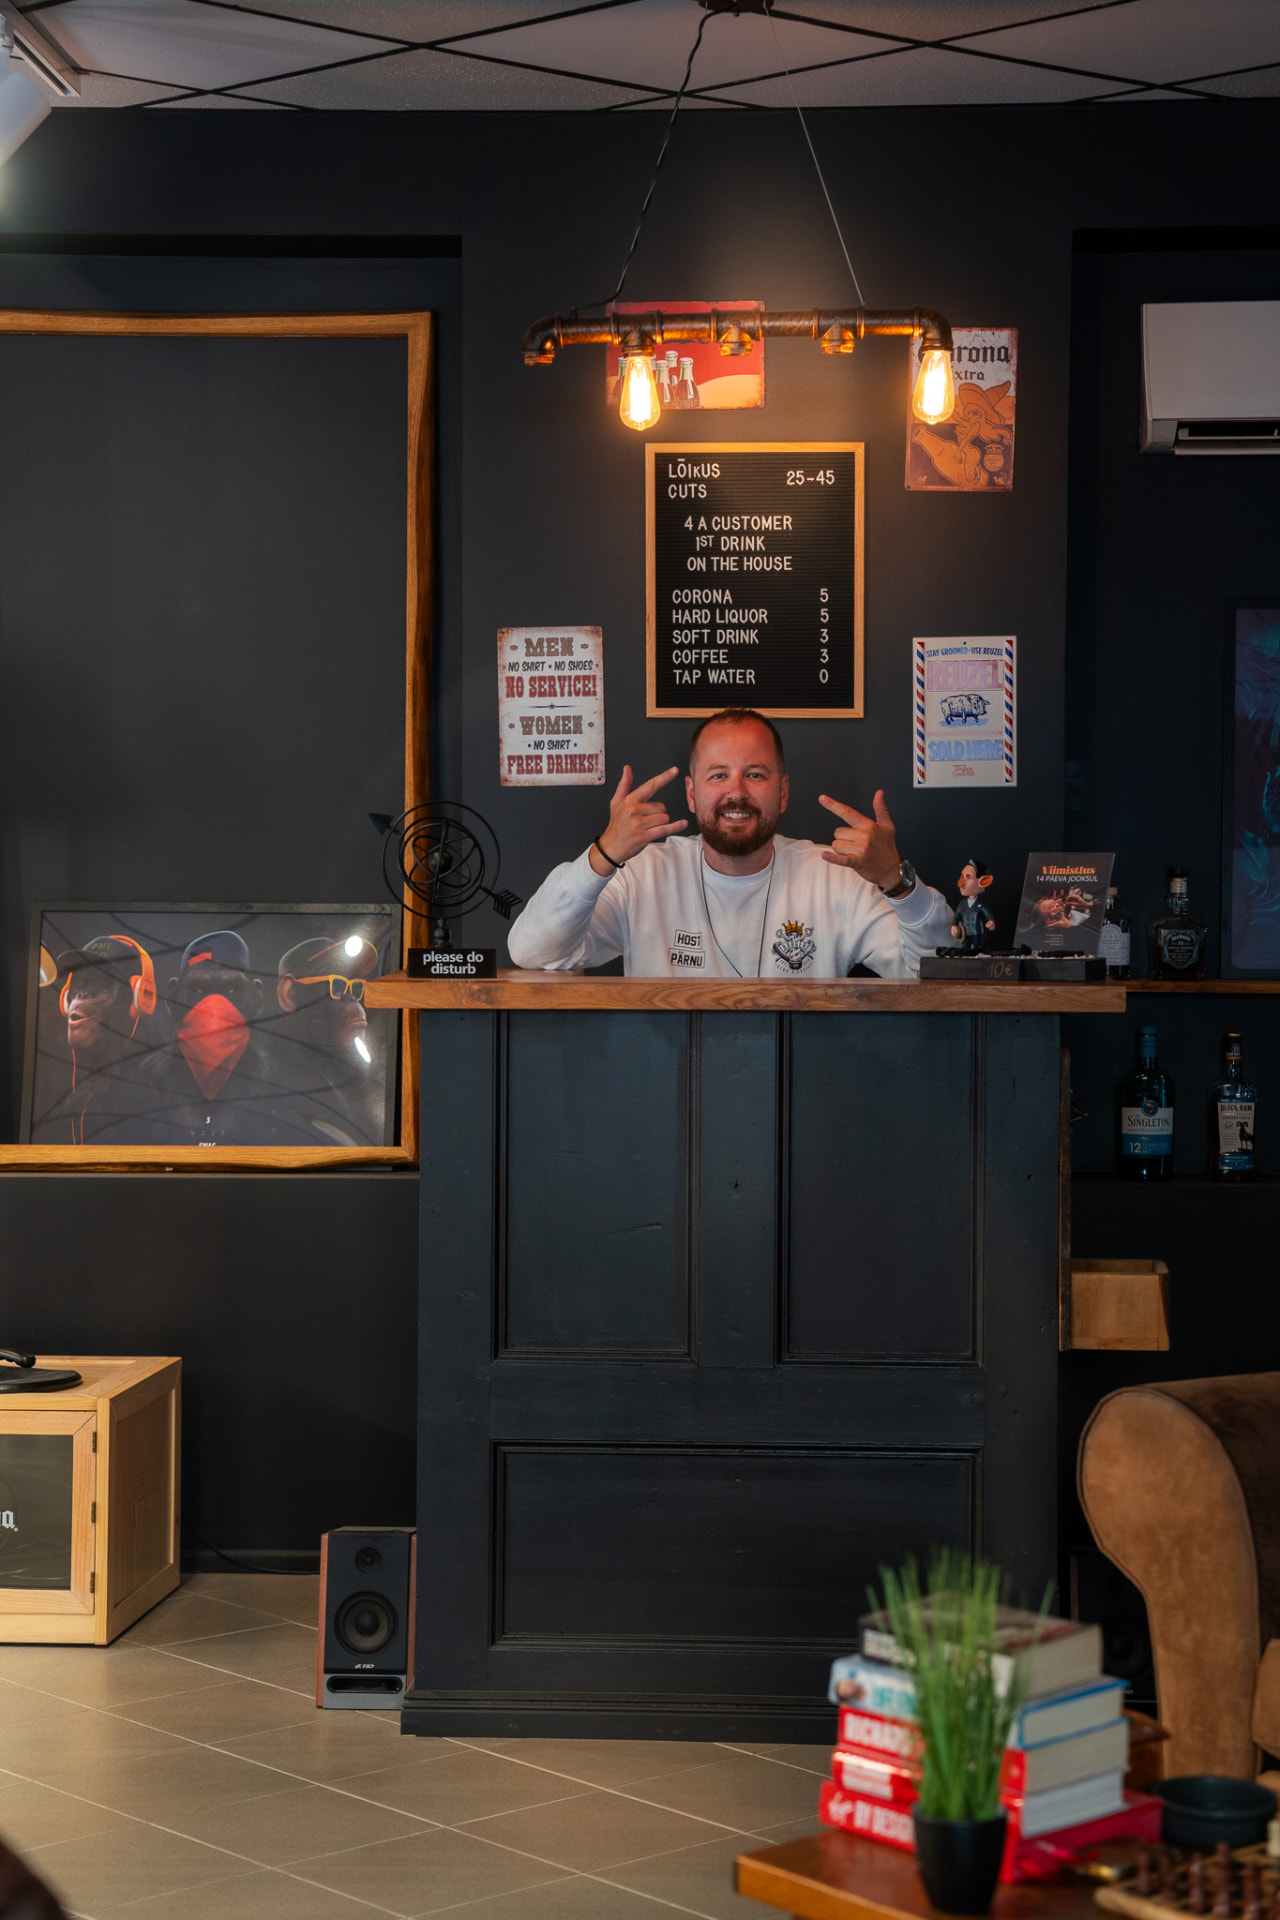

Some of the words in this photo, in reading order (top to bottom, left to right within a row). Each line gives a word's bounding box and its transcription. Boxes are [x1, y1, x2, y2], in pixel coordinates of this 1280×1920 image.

[786, 470, 835, 486] 25-45
[668, 484, 707, 499] CUTS
[684, 515, 694, 530] 4
[698, 515, 708, 530] A
[712, 515, 792, 531] CUSTOMER
[695, 535, 715, 551] 1ST
[721, 536, 765, 551] DRINK
[687, 556, 706, 572] ON
[711, 556, 739, 571] THE
[743, 556, 792, 571] HOUSE
[672, 589, 733, 604] CORONA
[819, 588, 829, 603] 5
[672, 609, 711, 624] HARD
[716, 609, 768, 624] LIQUOR
[819, 608, 829, 623] 5
[672, 629, 710, 644] SOFT
[717, 629, 759, 644] DRINK
[819, 629, 829, 644] 3
[525, 637, 574, 657] MEN
[926, 649, 940, 658] STAY
[940, 646, 968, 656] GROOMED
[971, 647, 982, 655] USE
[983, 647, 1004, 656] REUZEL
[672, 649, 728, 664] COFFEE
[819, 648, 829, 663] 3
[508, 662, 520, 672] NO
[522, 661, 546, 672] SHIRT
[554, 661, 566, 671] NO
[568, 660, 594, 671] SHOES
[673, 669, 702, 684] TAP
[708, 669, 755, 684] WATER
[927, 660, 1003, 690] REUZEL
[505, 676, 525, 698] NO
[529, 675, 597, 698] SERVICE!
[520, 715, 583, 736] WOMEN
[533, 740, 545, 750] NO
[547, 740, 571, 750] SHIRT
[928, 740, 965, 760] SOLD
[966, 740, 1003, 760] HERE
[507, 754, 543, 775] FREE
[547, 754, 599, 775] DRINKS!
[423, 951, 464, 965] please
[467, 951, 484, 962] do
[671, 951, 703, 967] PÄRNU
[431, 963, 477, 975] disturb
[1129, 1142, 1141, 1153] 12
